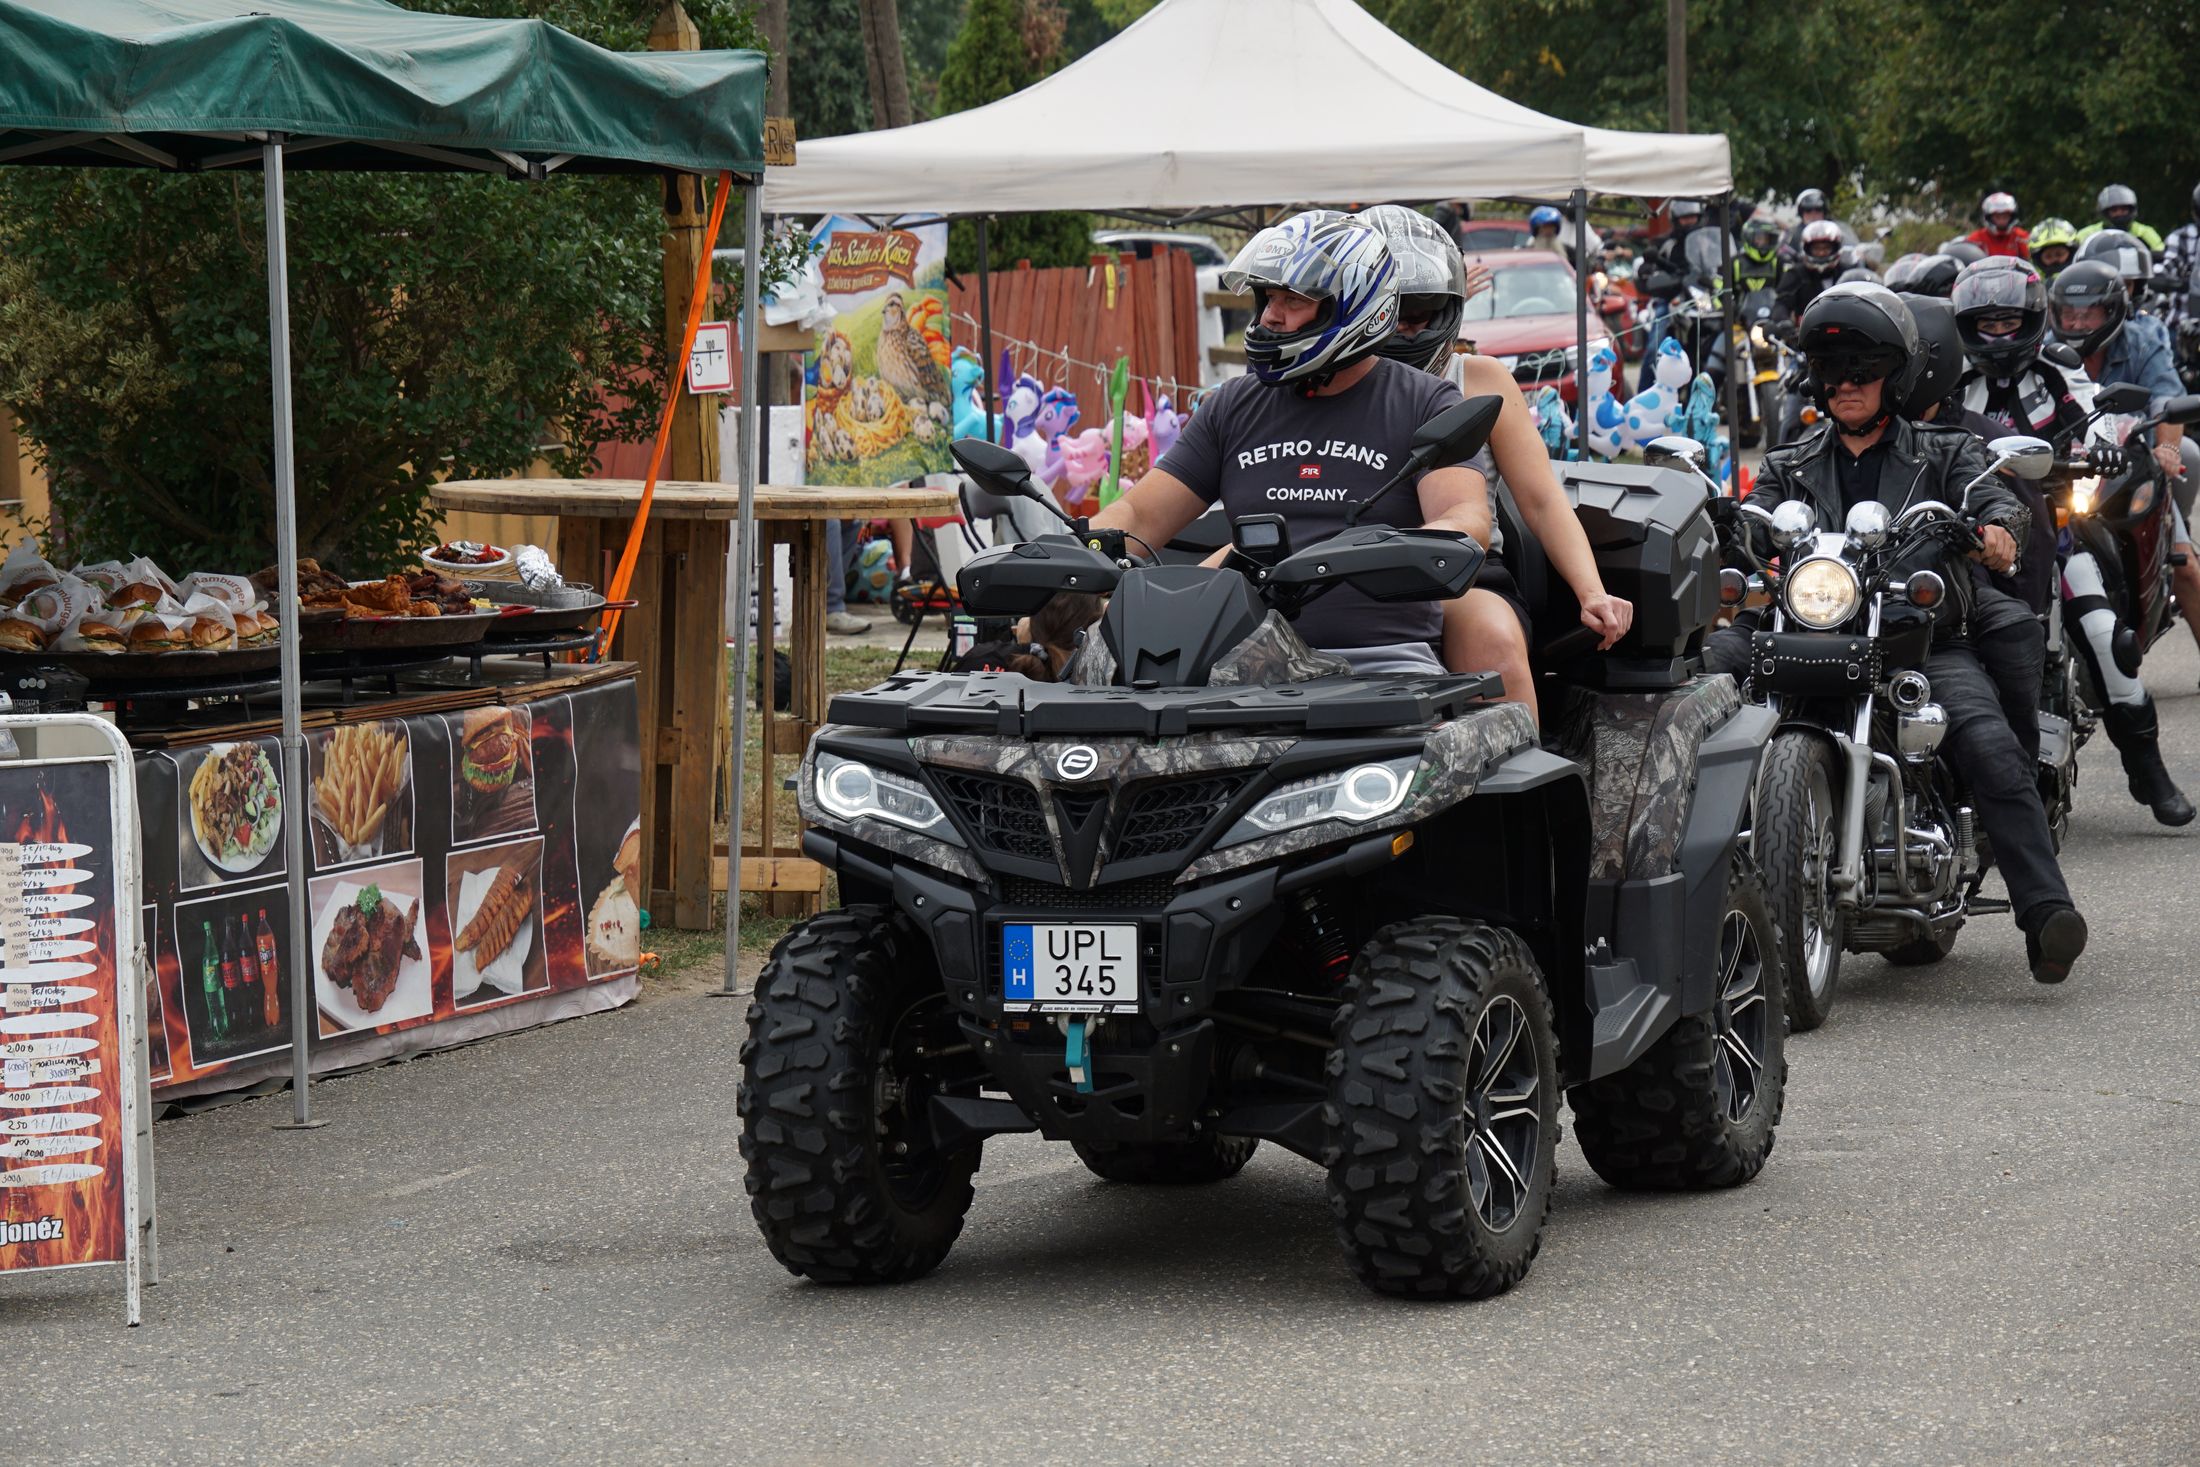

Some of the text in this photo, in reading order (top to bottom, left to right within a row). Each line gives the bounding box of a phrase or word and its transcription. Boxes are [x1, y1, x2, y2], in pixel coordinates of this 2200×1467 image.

[1369, 298, 1396, 331] SUOMY
[1237, 439, 1389, 471] RETRO JEANS
[1265, 486, 1348, 501] COMPANY
[1048, 929, 1122, 961] UPL
[1012, 968, 1027, 986] H
[1055, 964, 1116, 996] 345
[9, 1093, 31, 1102] 1000
[8, 1120, 28, 1131] 250
